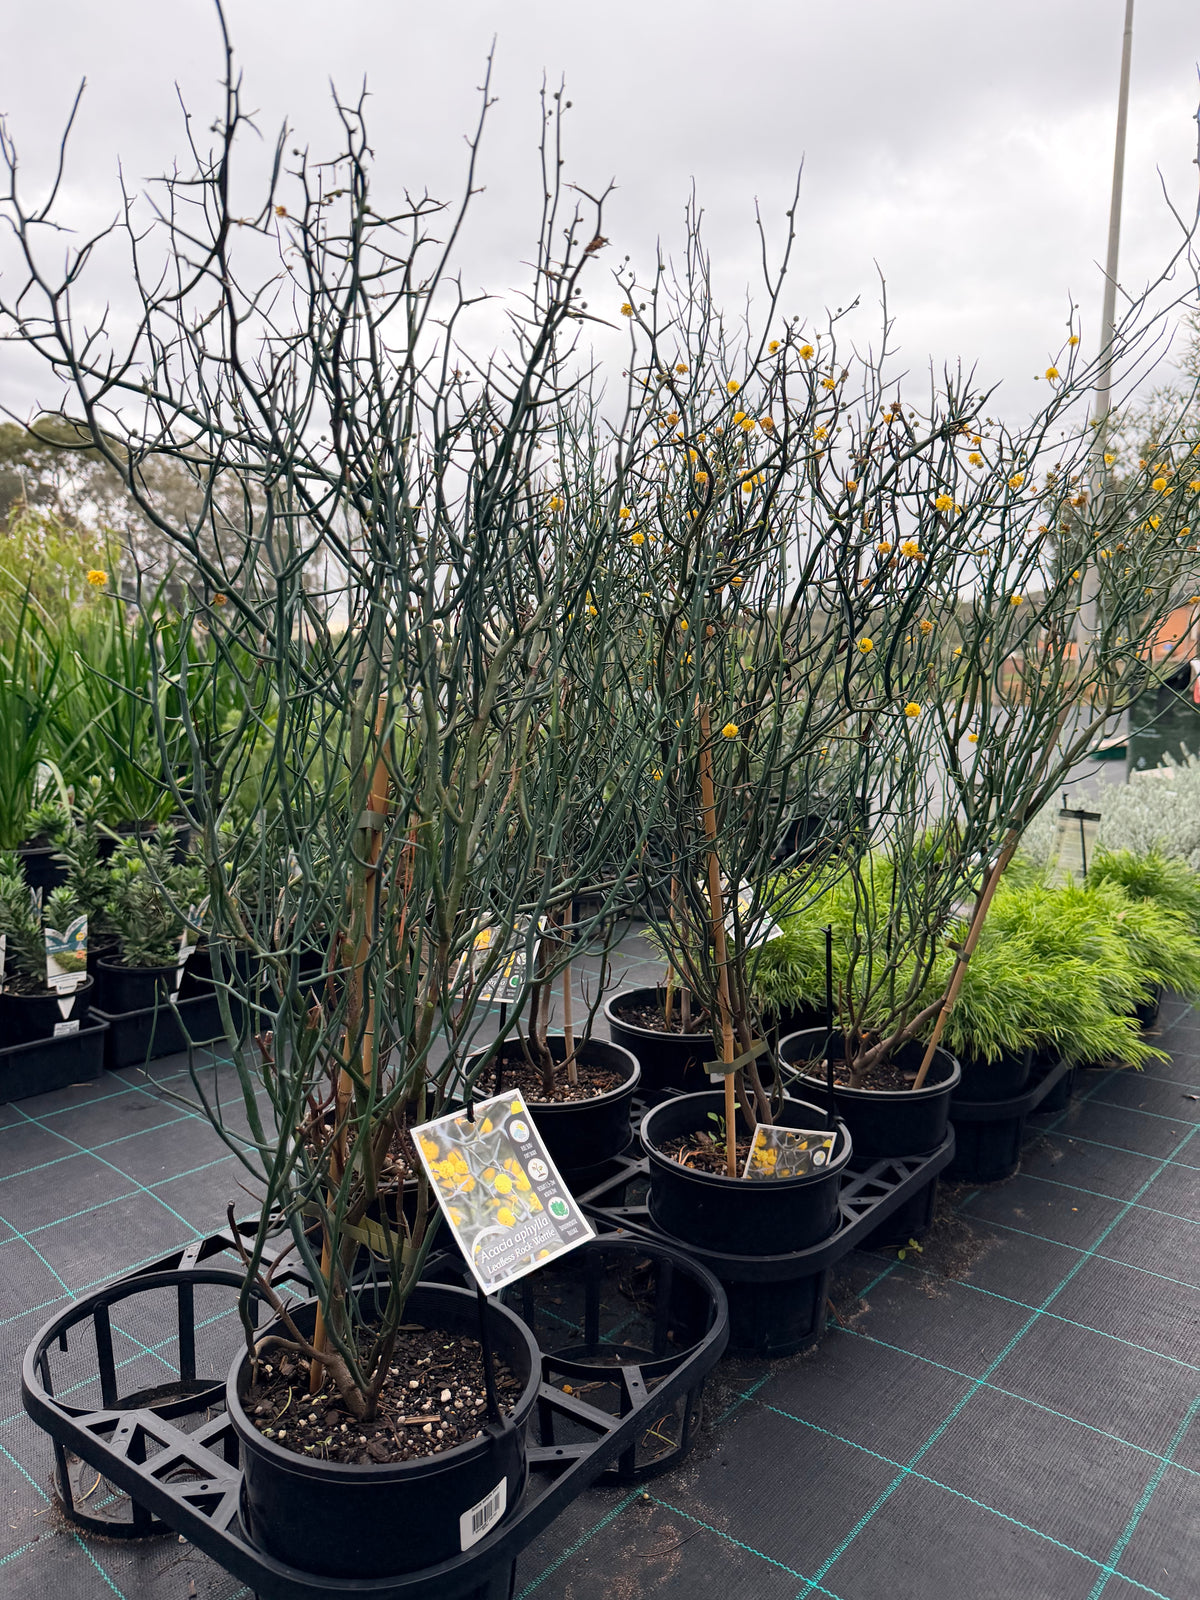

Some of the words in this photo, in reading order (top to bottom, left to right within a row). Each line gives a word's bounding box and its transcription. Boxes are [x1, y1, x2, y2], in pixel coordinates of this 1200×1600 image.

[481, 1237, 514, 1264] Acacia
[514, 1217, 549, 1243] aphylla
[487, 1253, 516, 1274] Leafless
[515, 1241, 534, 1258] Rock
[532, 1229, 555, 1246] Wattle
